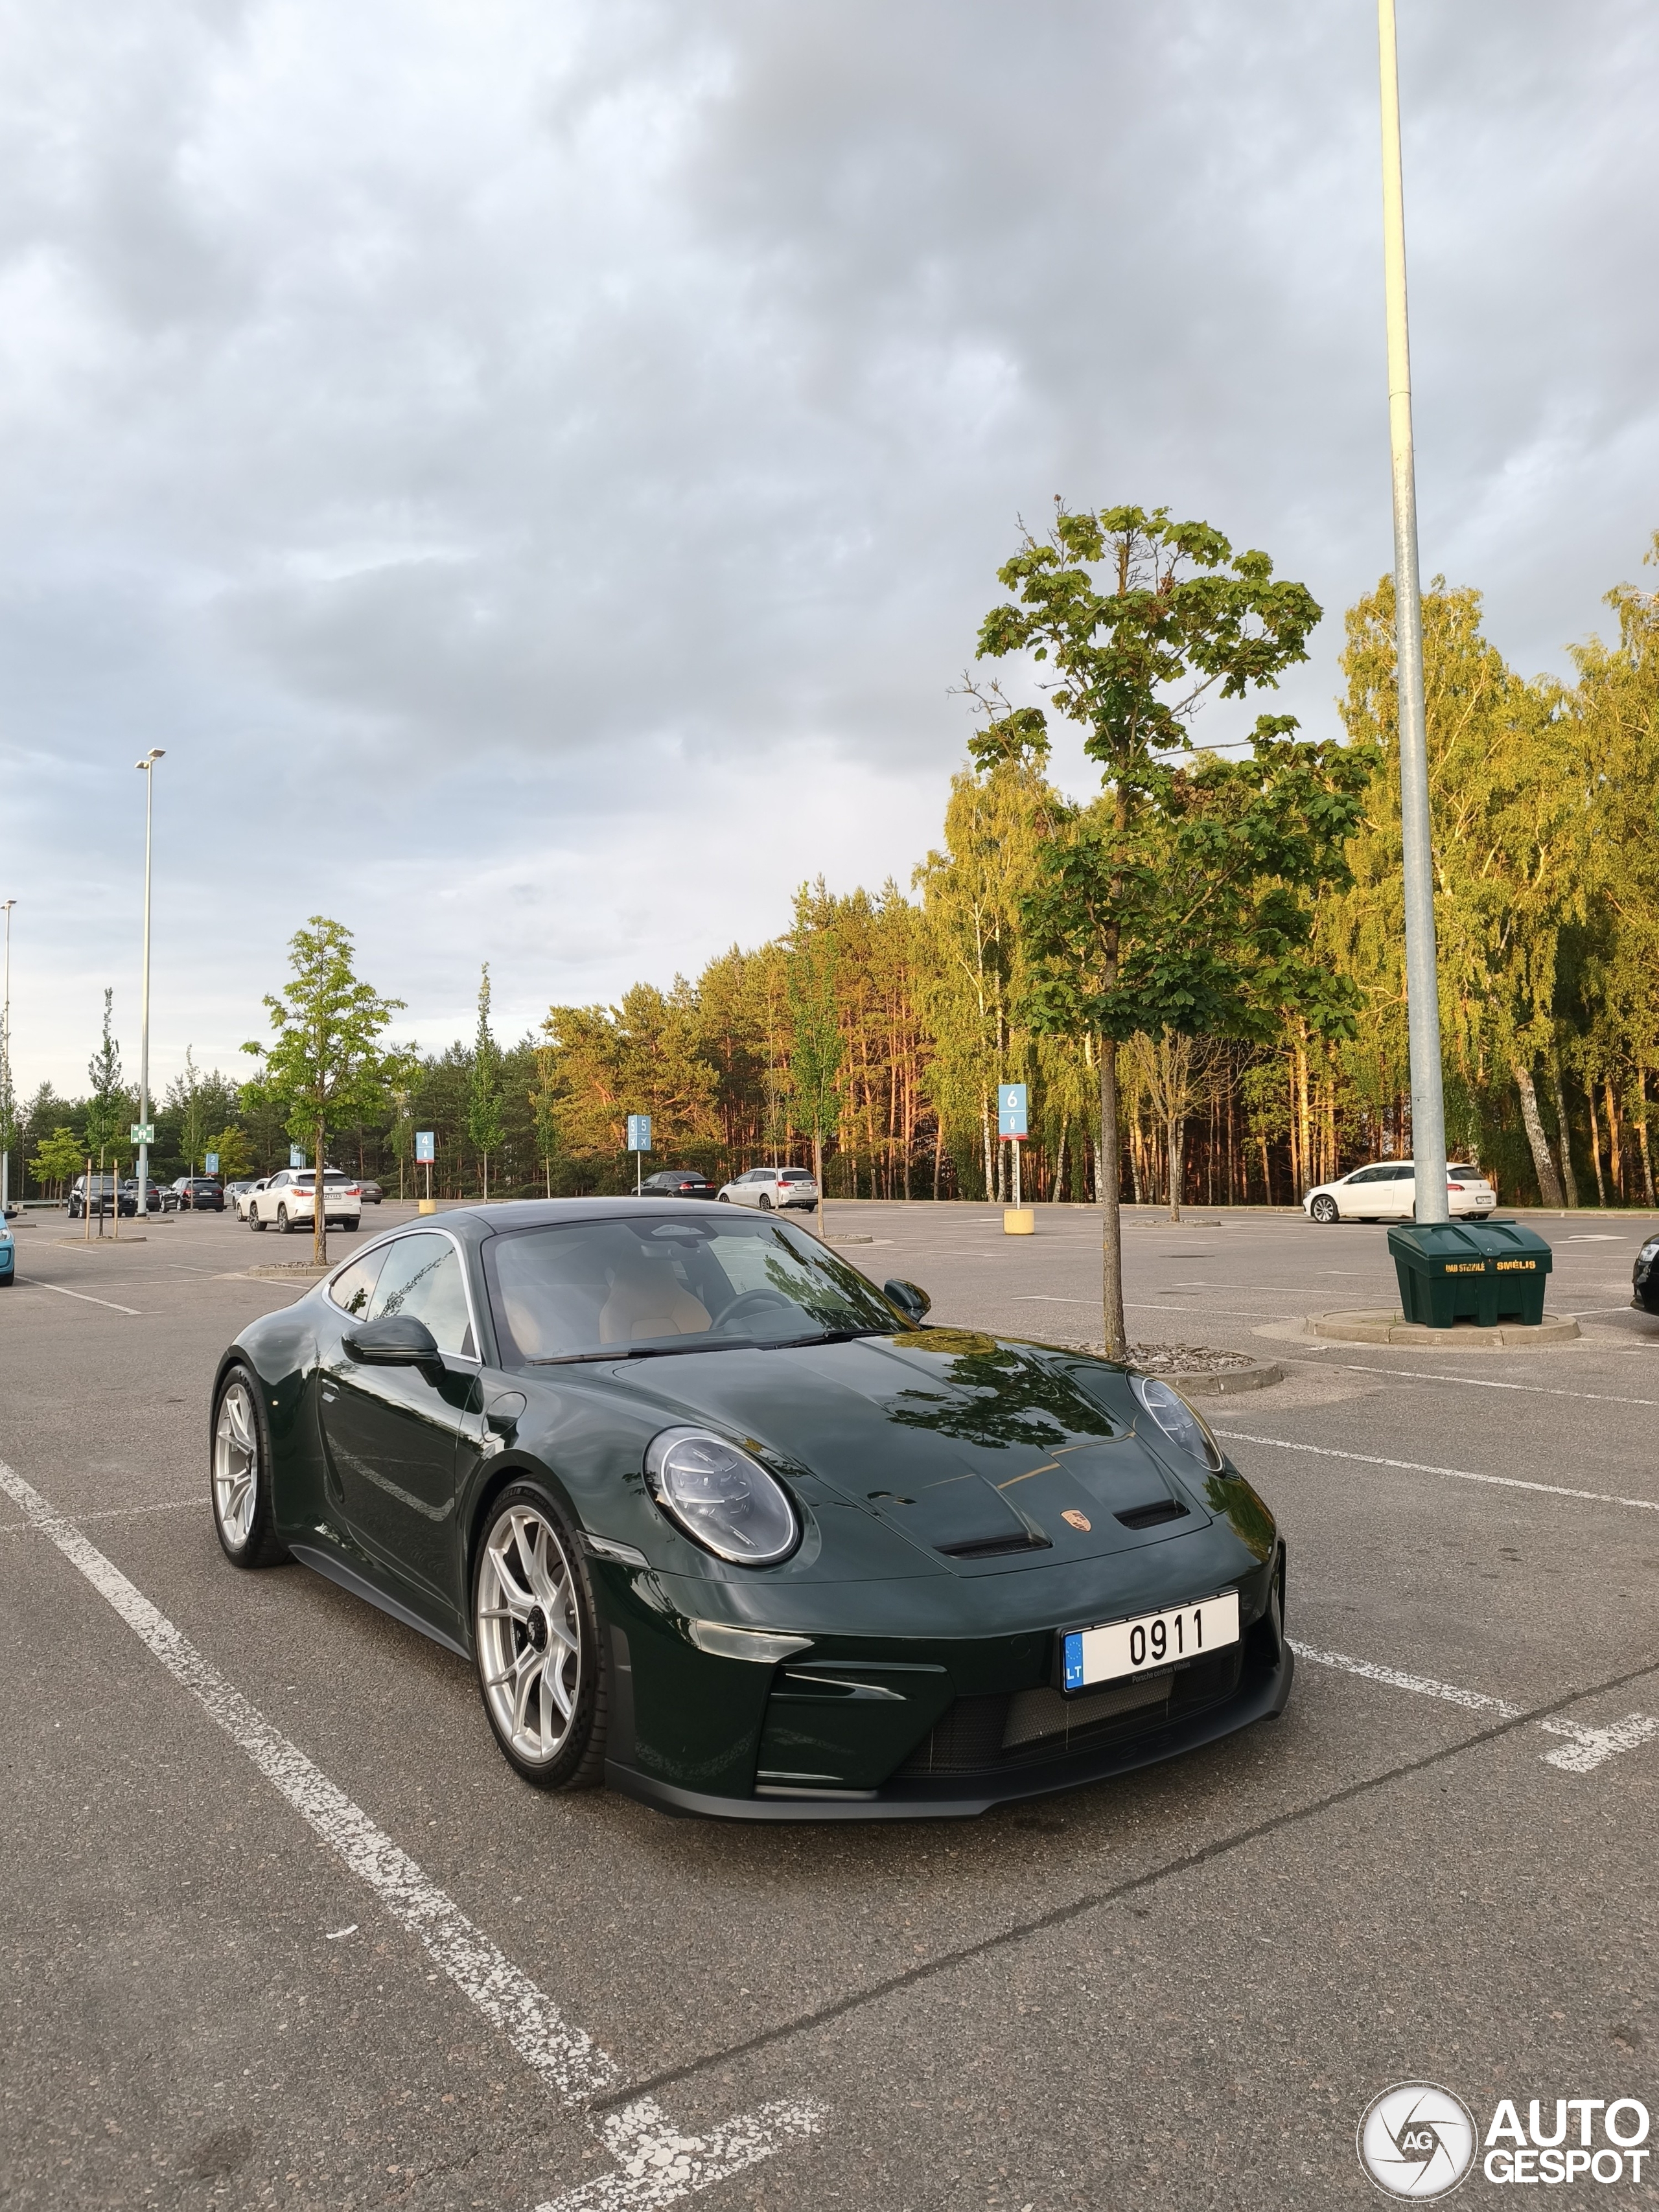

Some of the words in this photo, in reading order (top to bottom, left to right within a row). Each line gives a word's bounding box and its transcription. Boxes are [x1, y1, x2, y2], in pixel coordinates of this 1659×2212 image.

[1007, 1090, 1018, 1108] 6
[631, 1120, 635, 1132] 5
[641, 1119, 647, 1131] 5
[421, 1135, 429, 1145] 4
[1496, 1259, 1536, 1271] SMĖLIS
[1130, 1609, 1202, 1666] 0911
[1067, 1665, 1082, 1680] LT
[1132, 1671, 1153, 1684] Porsche
[1154, 1666, 1173, 1677] centras
[1173, 1661, 1191, 1672] Vilnius
